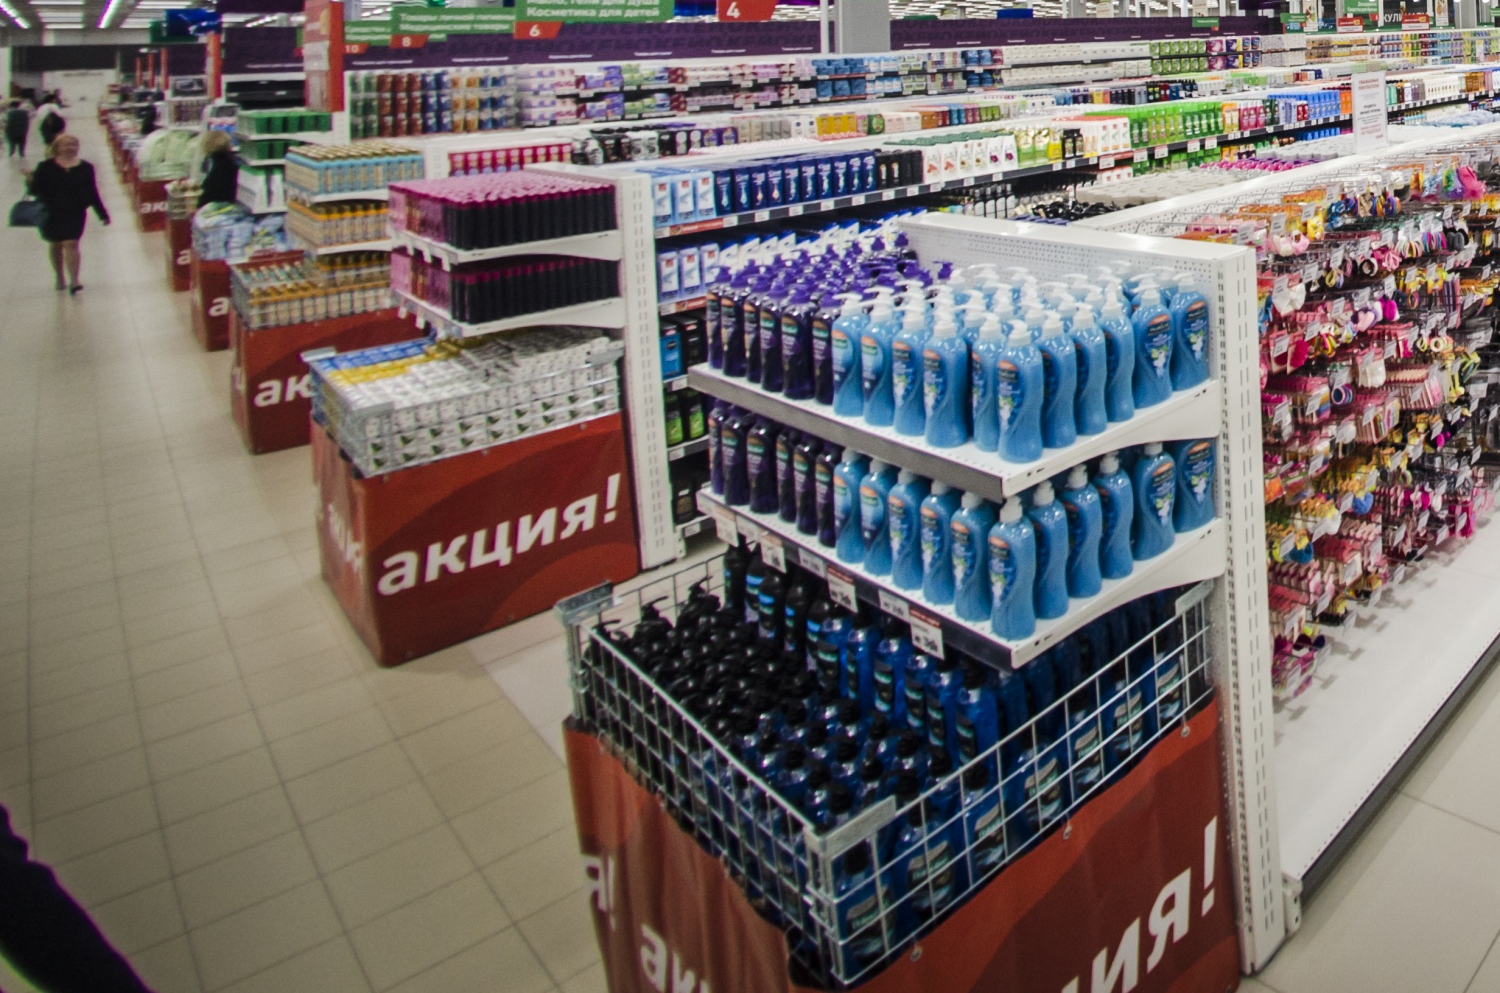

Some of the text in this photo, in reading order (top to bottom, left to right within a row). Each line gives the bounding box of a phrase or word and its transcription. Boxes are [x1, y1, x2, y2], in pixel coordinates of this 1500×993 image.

[526, 7, 660, 18] Косметика для детей
[726, 2, 741, 19] 4
[529, 23, 541, 37] 6
[402, 36, 412, 48] 8
[345, 44, 359, 54] 10
[377, 472, 621, 596] акция!
